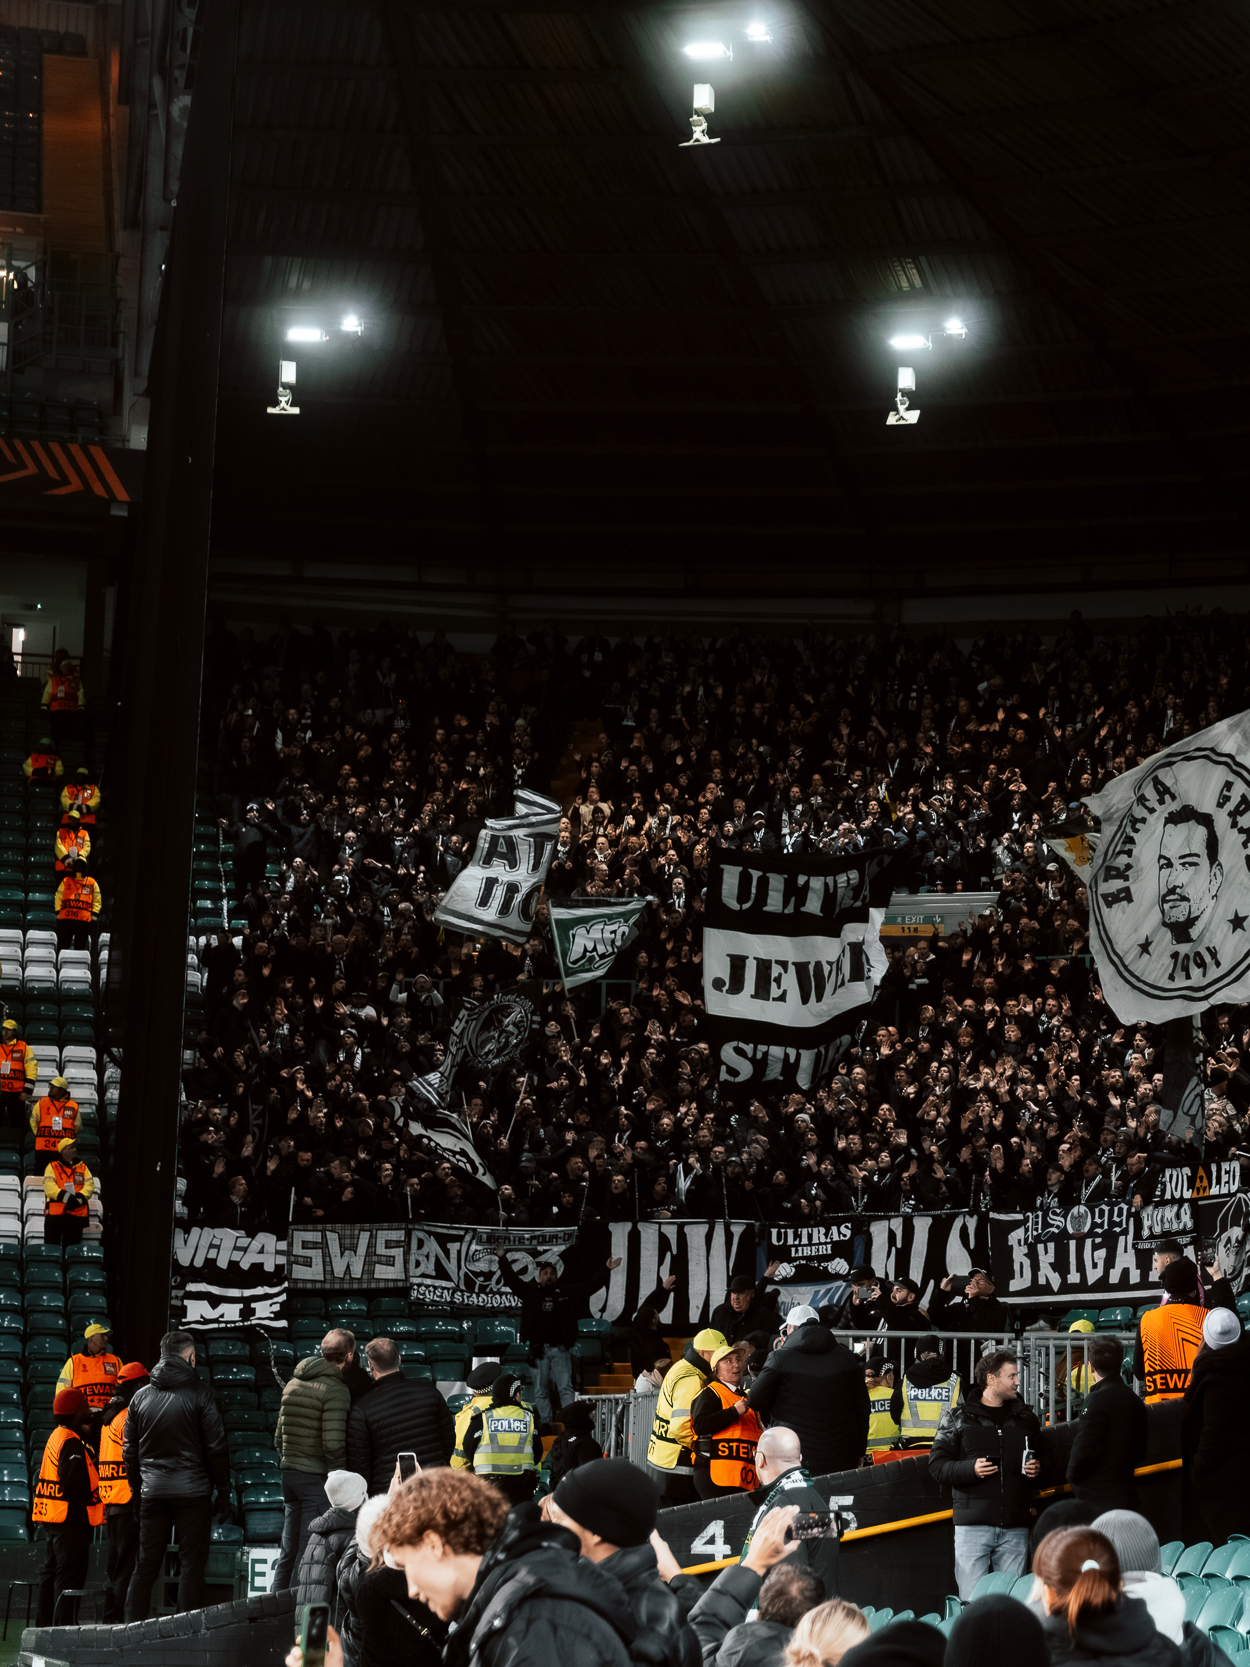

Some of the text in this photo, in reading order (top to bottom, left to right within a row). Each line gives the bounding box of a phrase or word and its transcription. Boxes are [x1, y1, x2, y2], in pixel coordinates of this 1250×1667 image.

[901, 926, 919, 934] 118
[905, 915, 925, 924] EXIT
[1167, 946, 1221, 982] 1994
[44, 1139, 60, 1148] 24
[1209, 1160, 1240, 1196] LEO
[1141, 1202, 1194, 1239] PUMA
[770, 1222, 852, 1246] ULTRAS
[291, 1229, 406, 1281] SWS
[791, 1243, 833, 1257] LIBERI
[1008, 1218, 1160, 1292] BRIGA
[589, 1222, 747, 1324] JEW
[410, 1284, 452, 1302] GEGEN
[911, 1388, 949, 1400] POLICE
[491, 1420, 527, 1432] POLICE
[690, 1519, 732, 1562] 4
